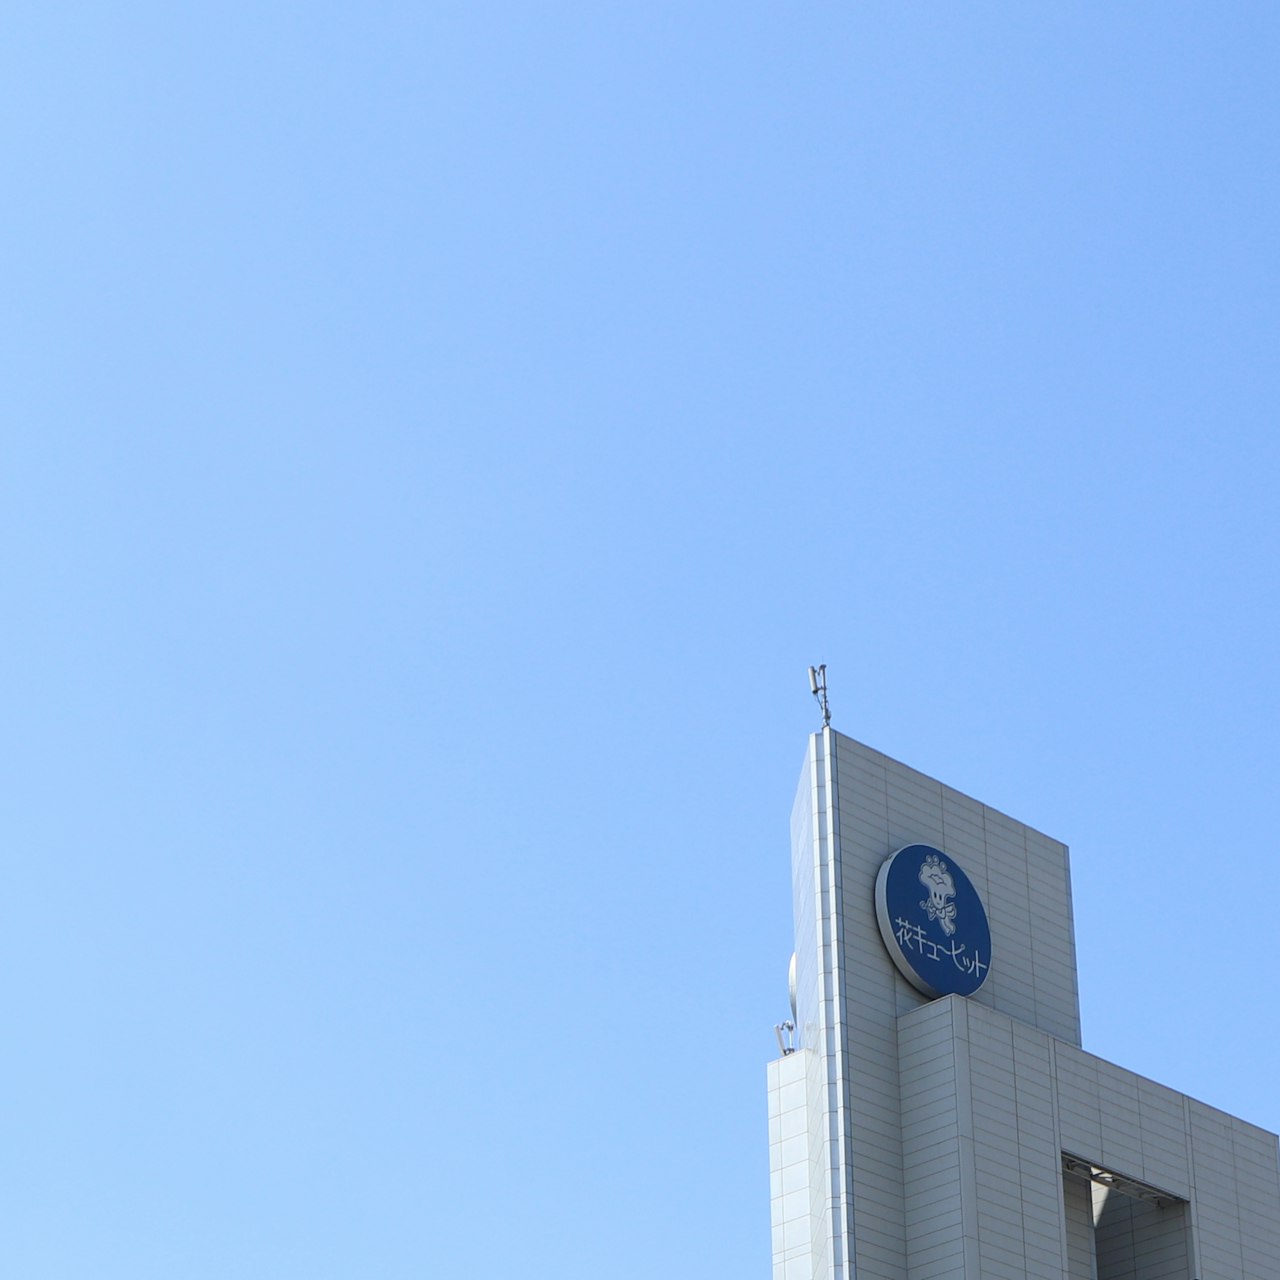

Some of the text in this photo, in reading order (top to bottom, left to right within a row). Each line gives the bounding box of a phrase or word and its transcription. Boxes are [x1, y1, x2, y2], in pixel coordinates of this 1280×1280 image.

[895, 916, 988, 978] 花キューピット
